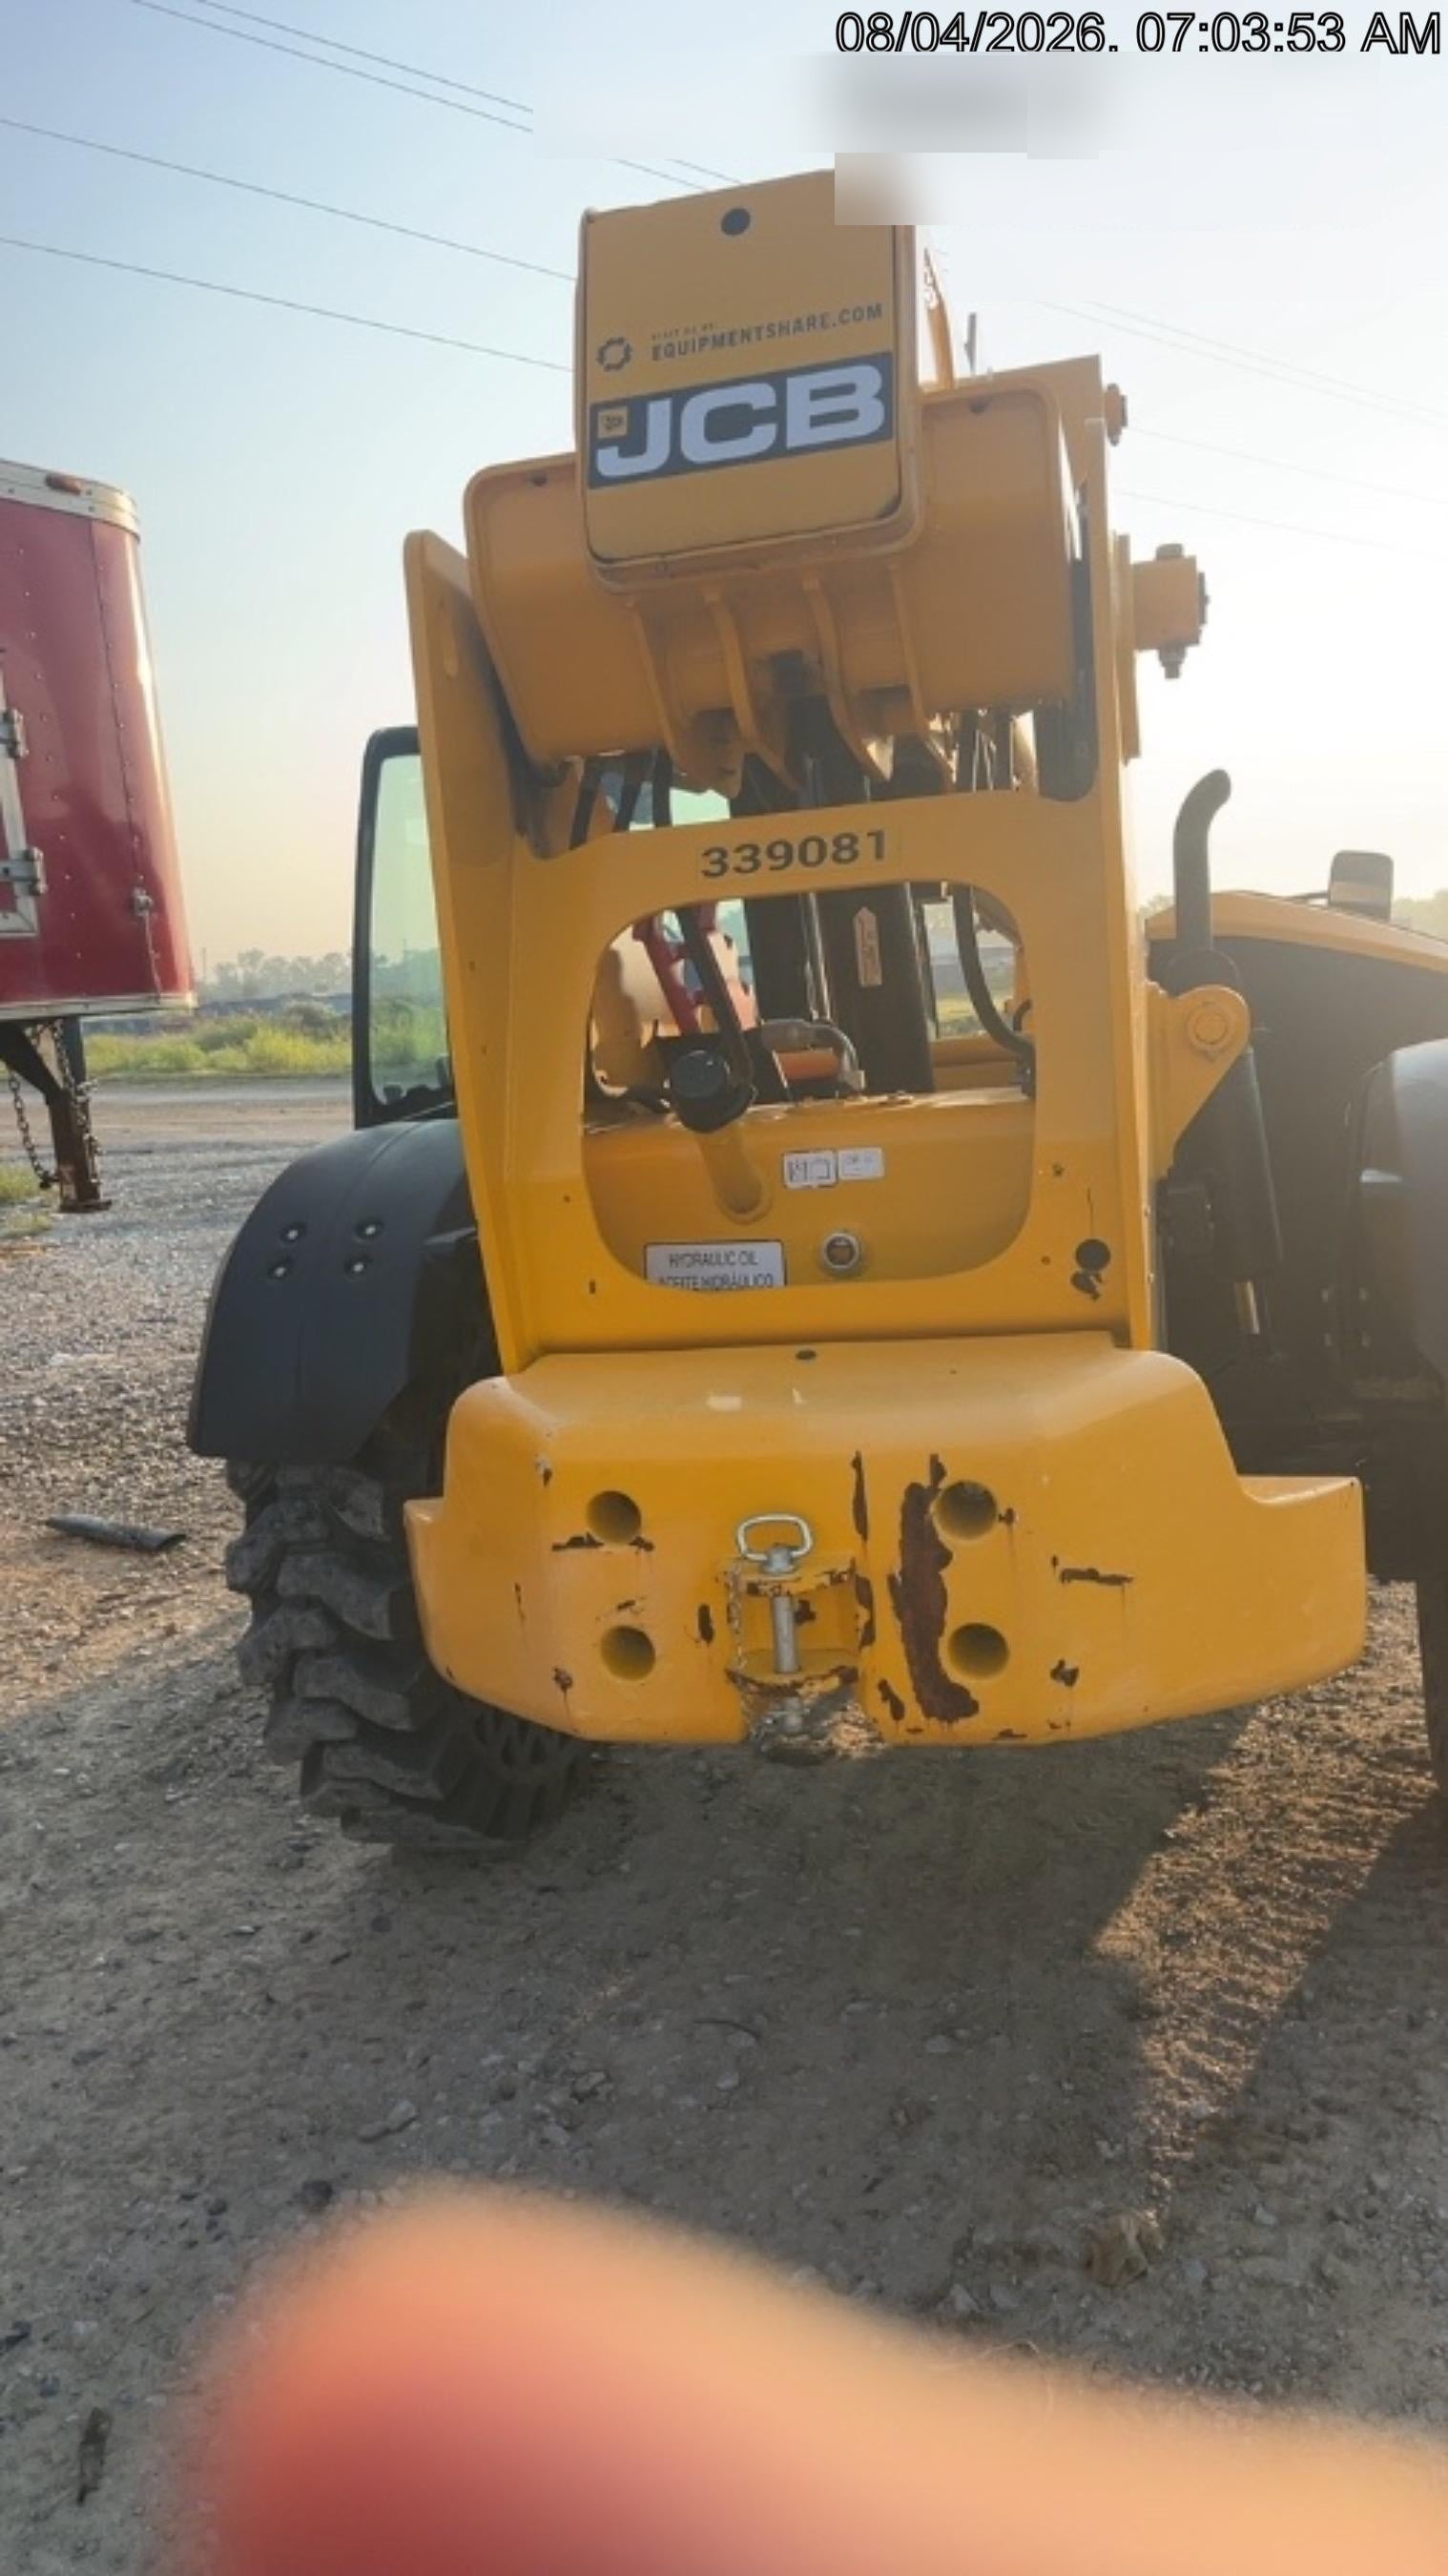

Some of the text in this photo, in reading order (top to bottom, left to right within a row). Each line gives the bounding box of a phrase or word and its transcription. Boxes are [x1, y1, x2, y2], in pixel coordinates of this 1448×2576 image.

[652, 302, 883, 361] EQUIPMENTSHARE.COM
[596, 364, 885, 477] JCB
[701, 829, 885, 879] 339081
[669, 1250, 759, 1267] HYDRAULIC OIL
